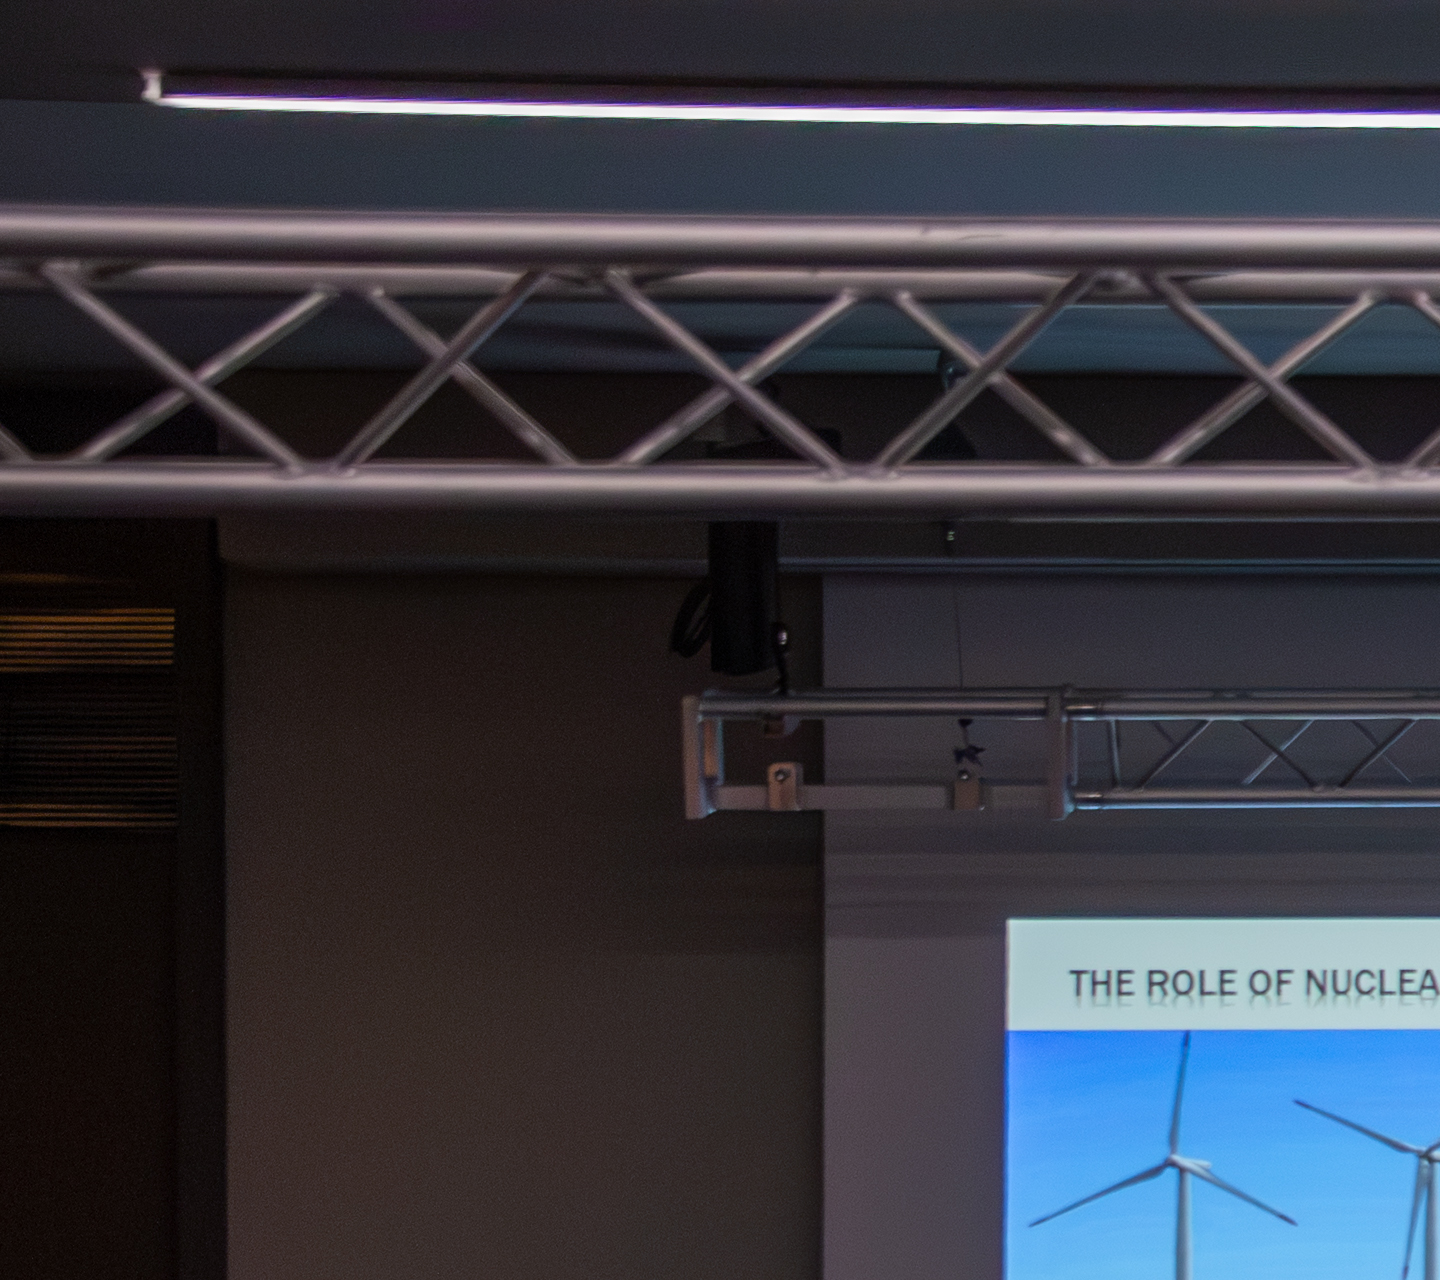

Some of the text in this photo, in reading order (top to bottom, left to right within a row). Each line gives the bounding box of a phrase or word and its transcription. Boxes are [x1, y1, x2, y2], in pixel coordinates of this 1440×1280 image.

[1068, 968, 1135, 999] THE
[1146, 968, 1237, 999] ROLE
[1247, 968, 1295, 998] OF
